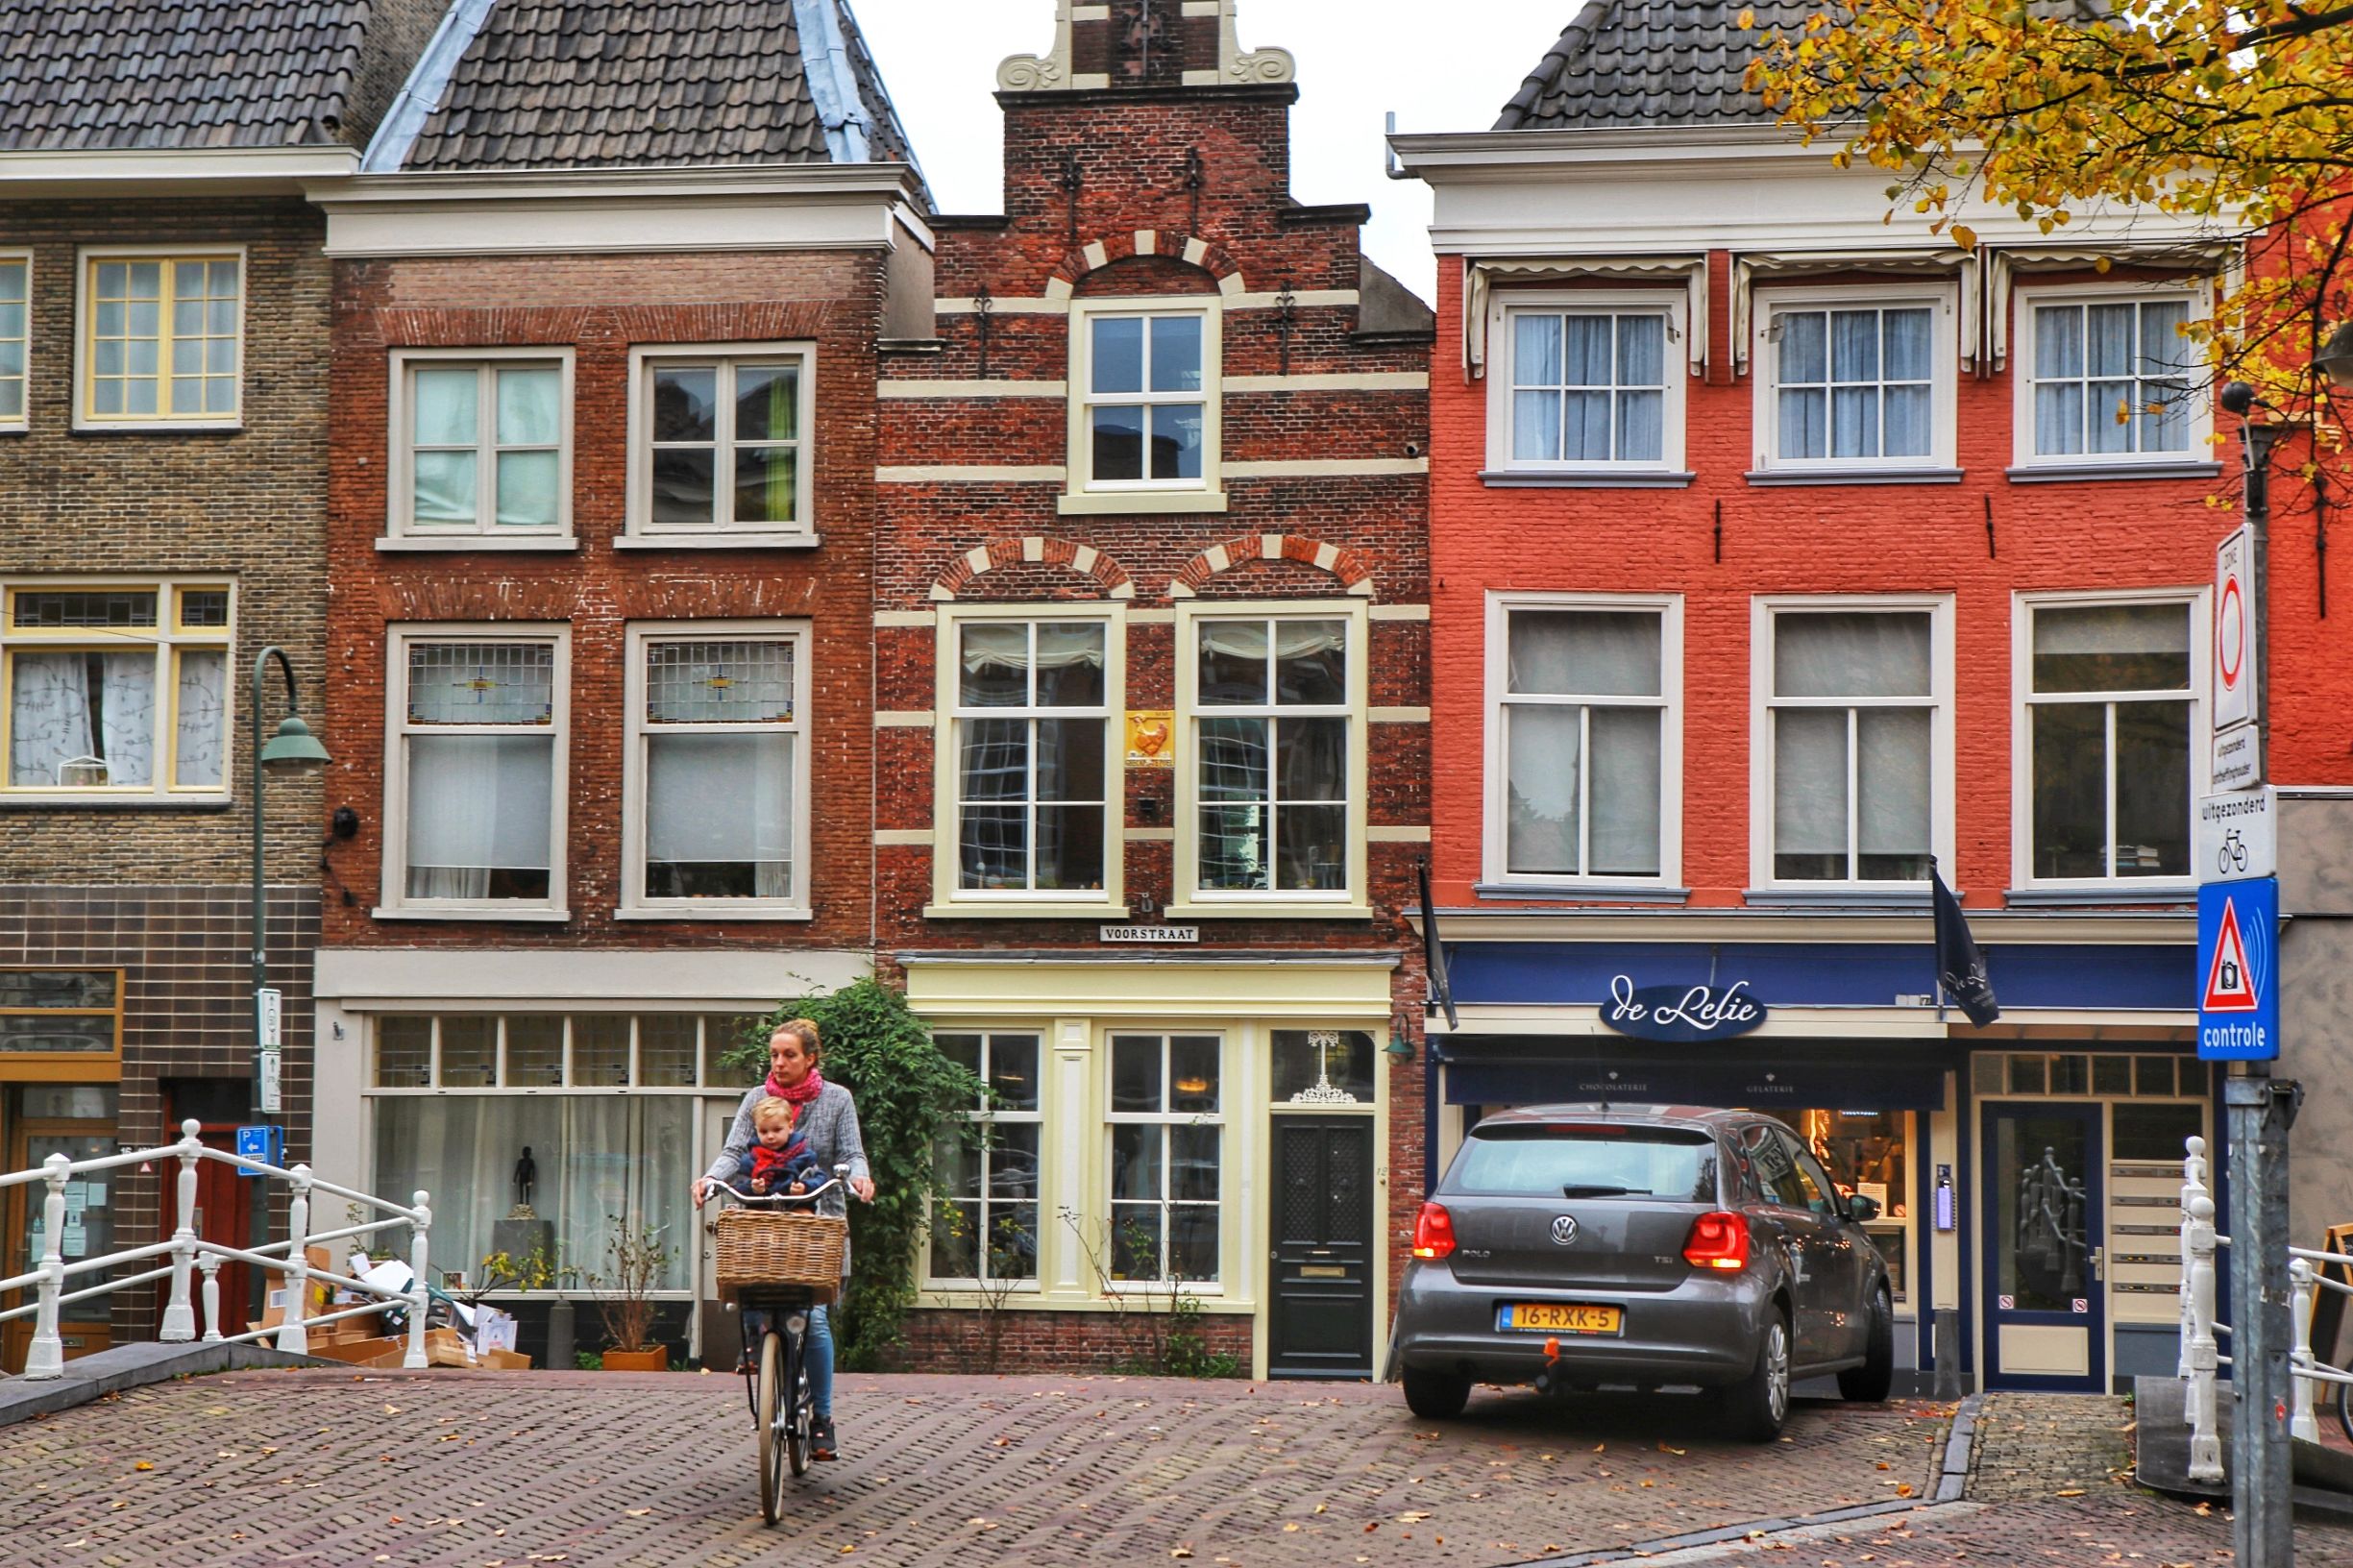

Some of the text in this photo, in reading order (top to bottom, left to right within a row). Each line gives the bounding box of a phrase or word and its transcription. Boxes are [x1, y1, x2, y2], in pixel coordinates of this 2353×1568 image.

[2202, 794, 2266, 823] uitgezonderd
[1106, 929, 1193, 940] VOORSTRAAT
[1611, 974, 1757, 1031] de Lelie
[2203, 1021, 2266, 1047] controle
[243, 1131, 251, 1141] P
[1462, 1249, 1491, 1258] POLO
[1521, 1307, 1609, 1328] 16-RXK-5
